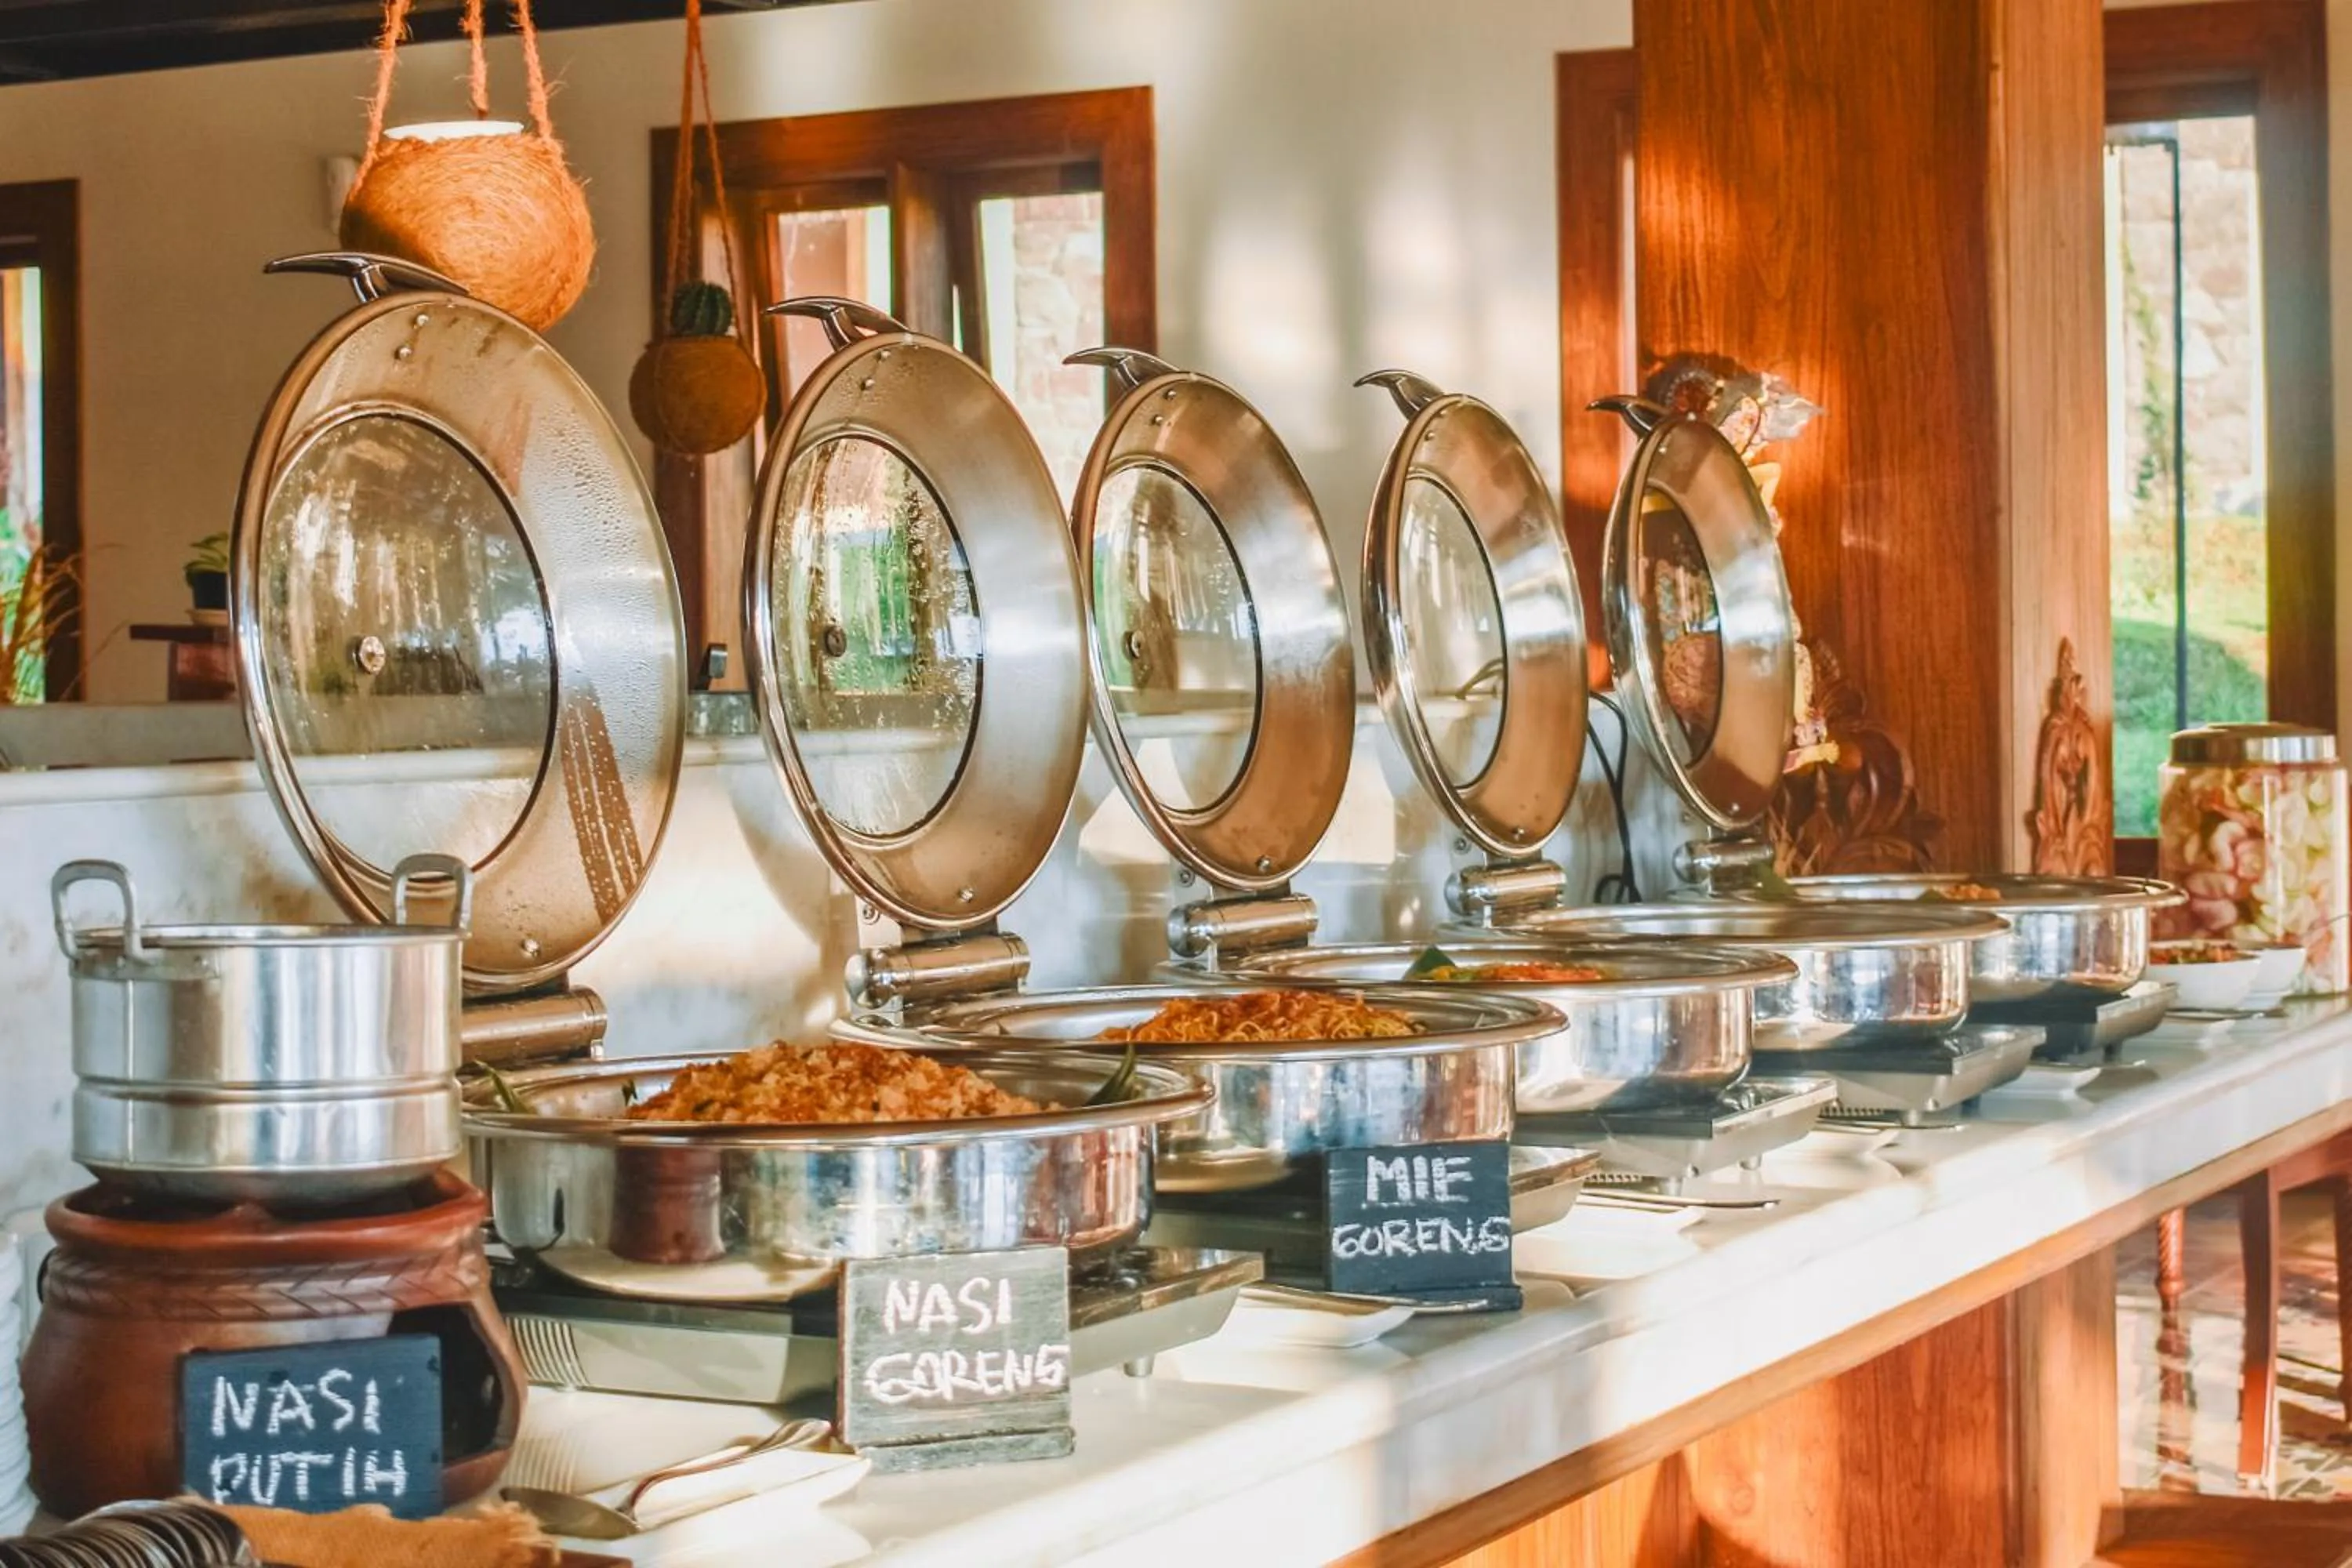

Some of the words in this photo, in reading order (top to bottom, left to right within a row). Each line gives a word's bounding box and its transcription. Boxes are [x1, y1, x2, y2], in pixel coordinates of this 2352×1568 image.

[1366, 1155, 1473, 1203] MIE
[1332, 1216, 1512, 1260] GORENG
[883, 1276, 1012, 1335] NASI
[212, 1368, 382, 1437] NASI
[863, 1344, 1071, 1403] GORENG
[209, 1446, 408, 1505] PUTIH
